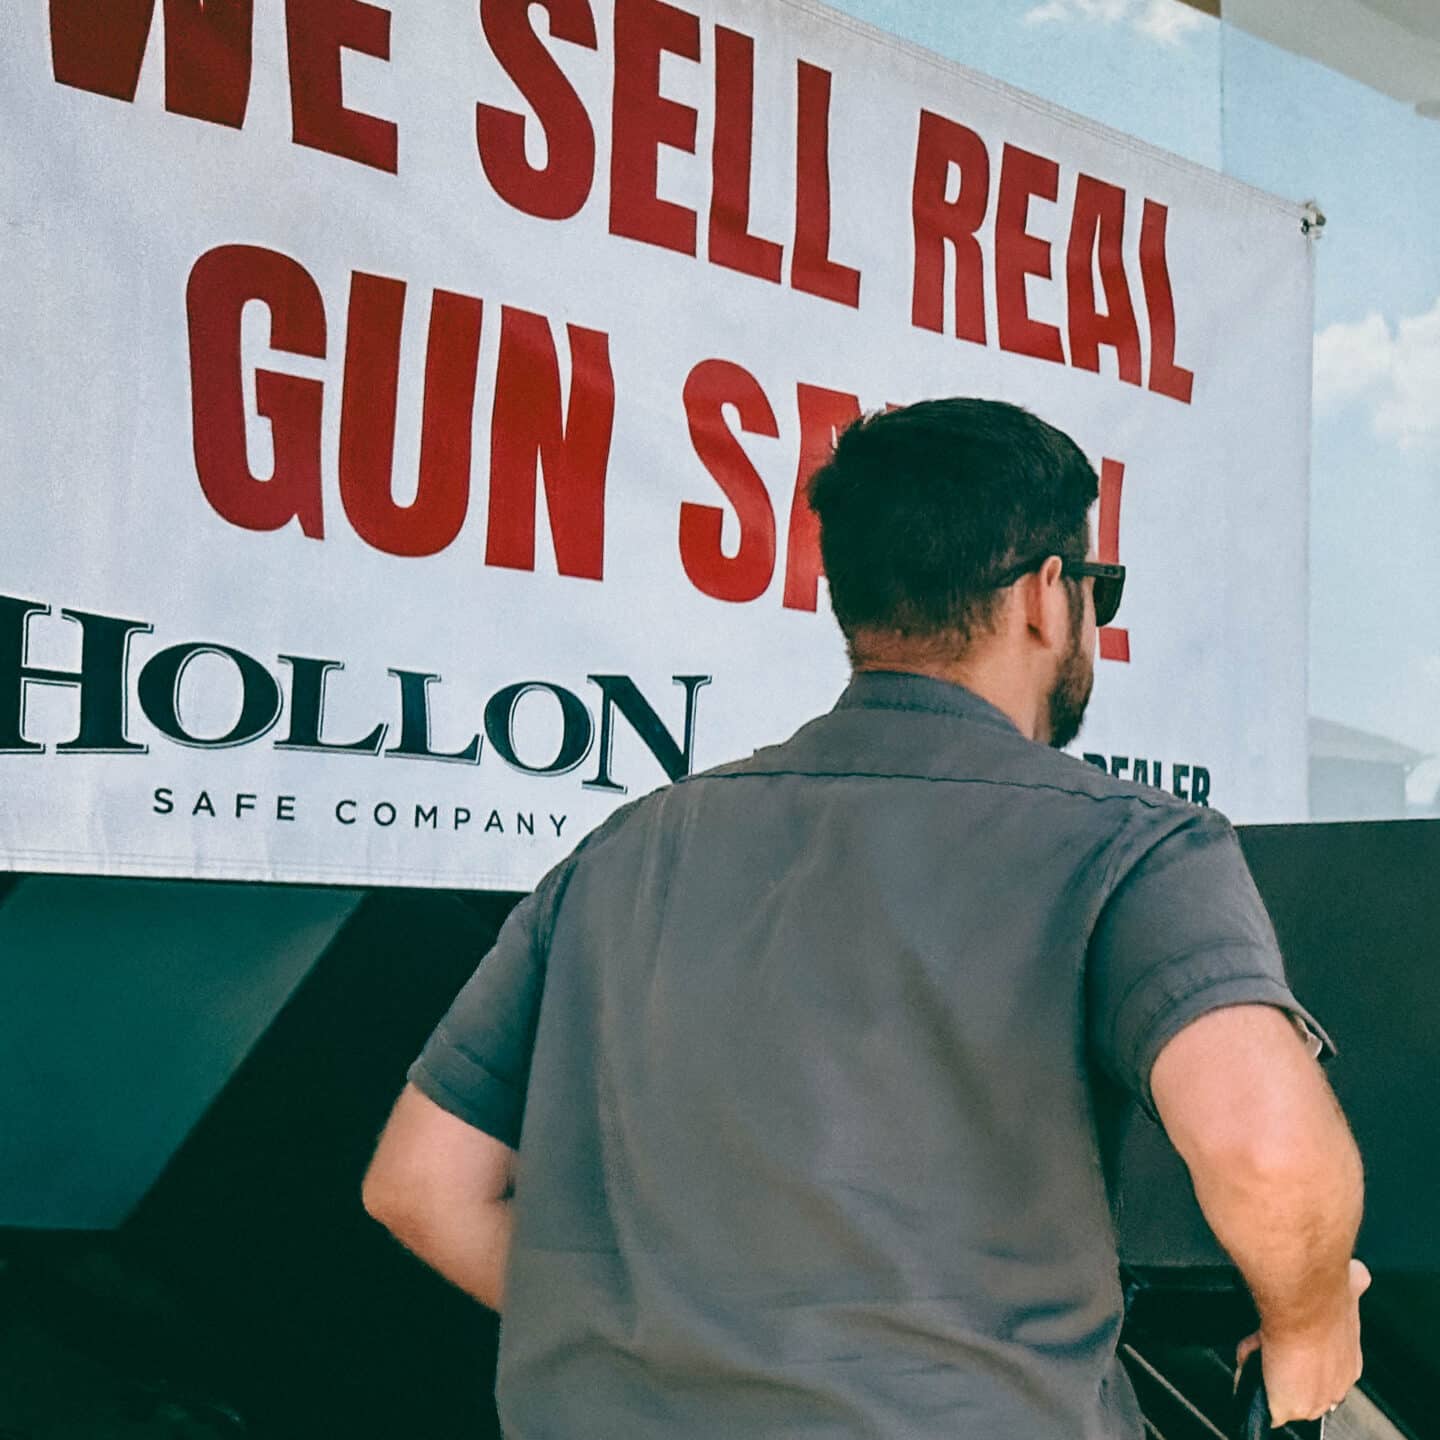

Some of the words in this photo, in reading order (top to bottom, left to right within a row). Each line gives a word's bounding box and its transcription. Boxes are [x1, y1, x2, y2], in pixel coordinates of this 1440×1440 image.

[475, 0, 861, 309] SELL
[911, 108, 1194, 405] REAL
[186, 243, 616, 582] GUN
[0, 594, 712, 795] HOLLON
[152, 787, 297, 821] SAFE
[334, 799, 570, 838] COMPANY
